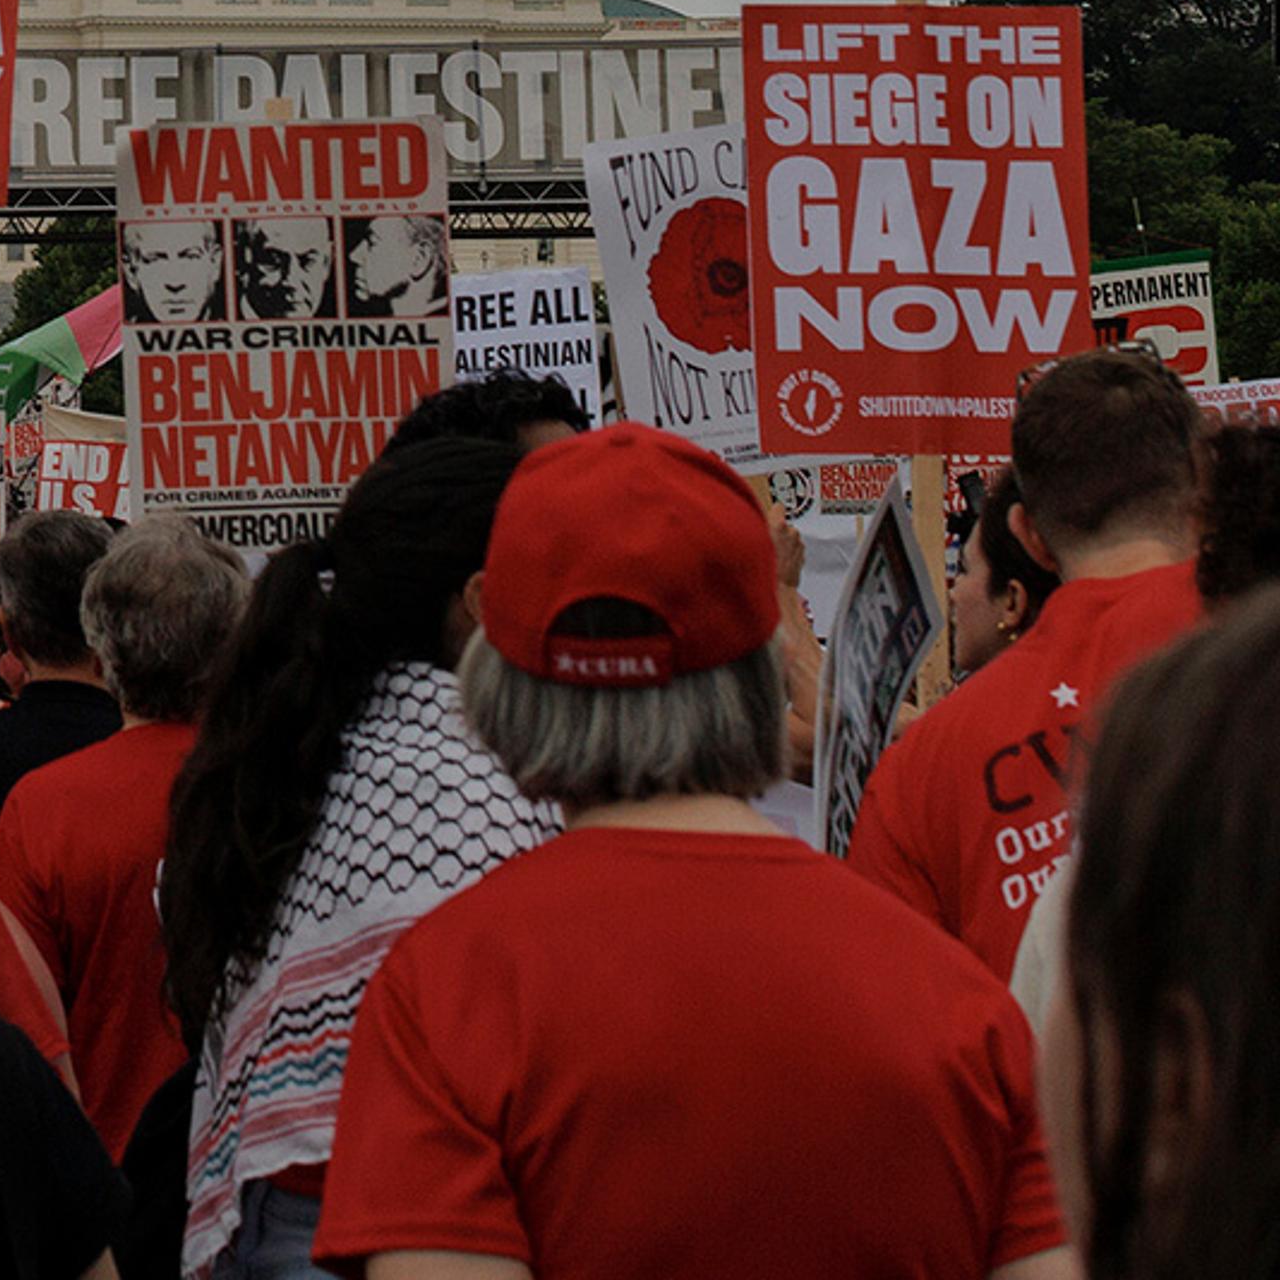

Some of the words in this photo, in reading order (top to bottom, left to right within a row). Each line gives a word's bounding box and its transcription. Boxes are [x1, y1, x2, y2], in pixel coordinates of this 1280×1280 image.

[762, 23, 910, 63] LIFT
[924, 24, 1062, 65] THE
[16, 55, 181, 166] REE
[762, 72, 952, 147] SIEGE
[965, 74, 1064, 149] ON
[129, 123, 430, 206] WANTED
[609, 146, 700, 259] FUND
[765, 155, 1076, 278] GAZA
[455, 291, 518, 333] REE
[530, 285, 590, 326] ALL
[773, 284, 1078, 354] NOW
[1091, 271, 1210, 311] PERMANENT
[136, 326, 233, 352] WAR
[241, 322, 439, 349] CRIMINAL
[455, 338, 593, 374] ALESTINIAN
[139, 347, 440, 425] BENJAMIN
[643, 322, 711, 428] NOT
[858, 395, 1016, 419] SHUTITDOWN4PALEST
[42, 442, 111, 483] END
[143, 491, 182, 504] FOR
[185, 489, 258, 503] CRIMES
[260, 487, 342, 501] AGAINST
[994, 809, 1069, 866] Our
